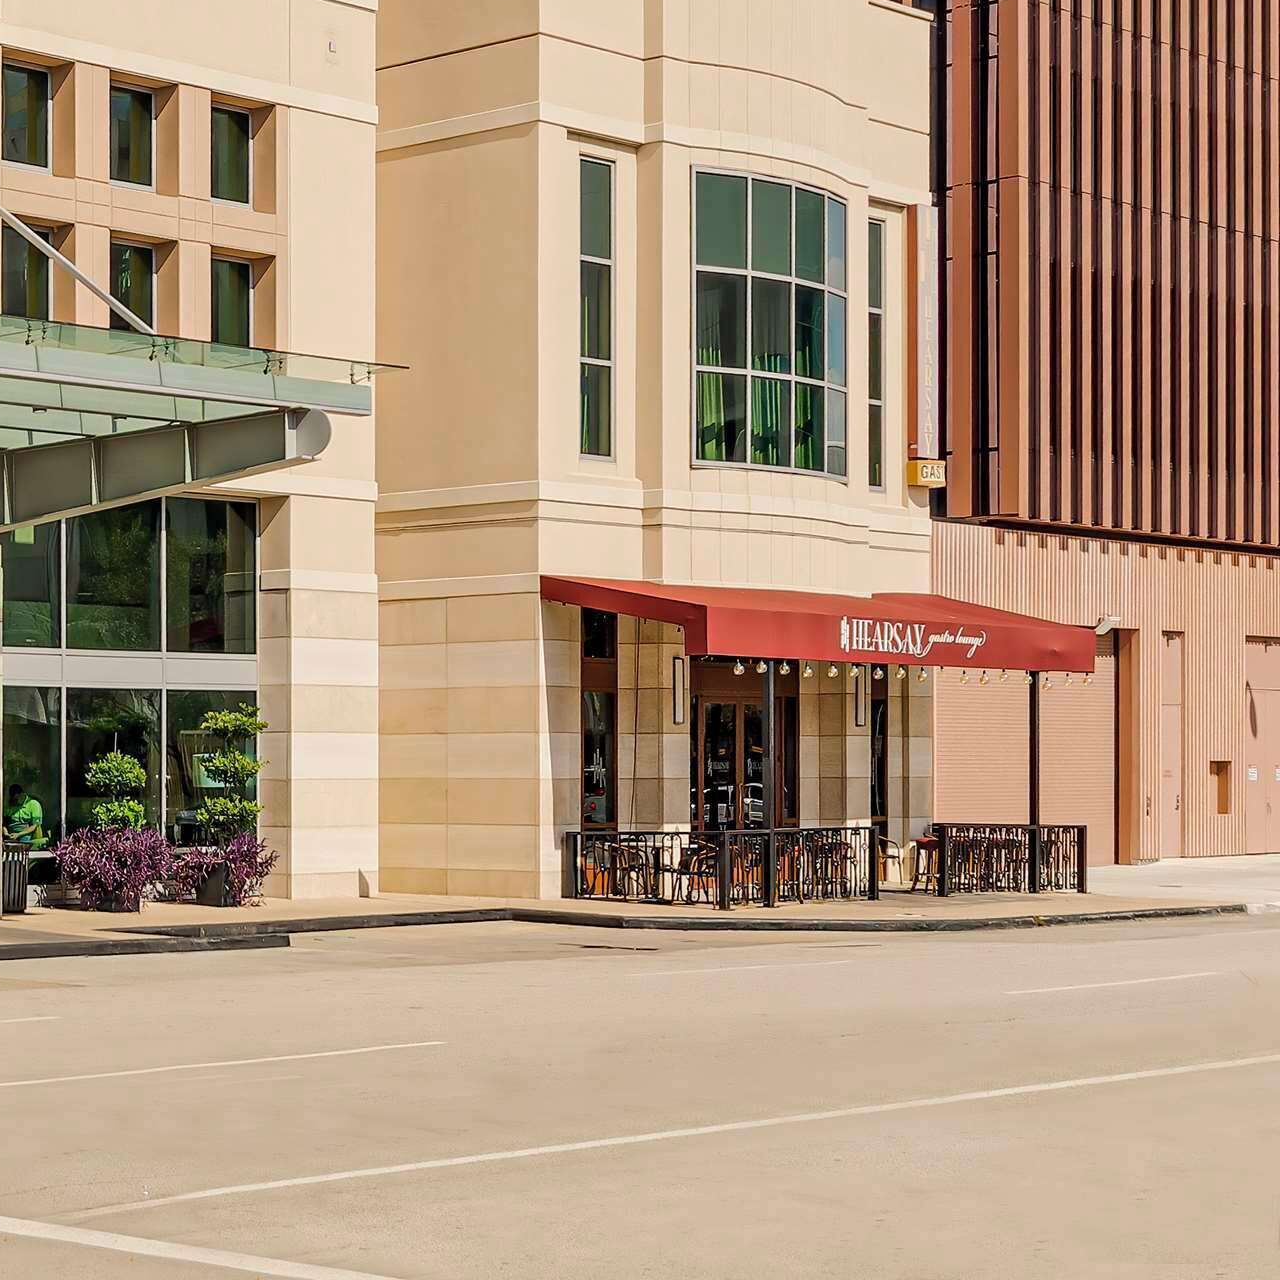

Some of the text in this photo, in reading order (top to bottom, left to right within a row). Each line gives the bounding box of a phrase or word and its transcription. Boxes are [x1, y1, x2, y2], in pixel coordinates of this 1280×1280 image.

[851, 618, 987, 658] HEARSAY gastro lounge
